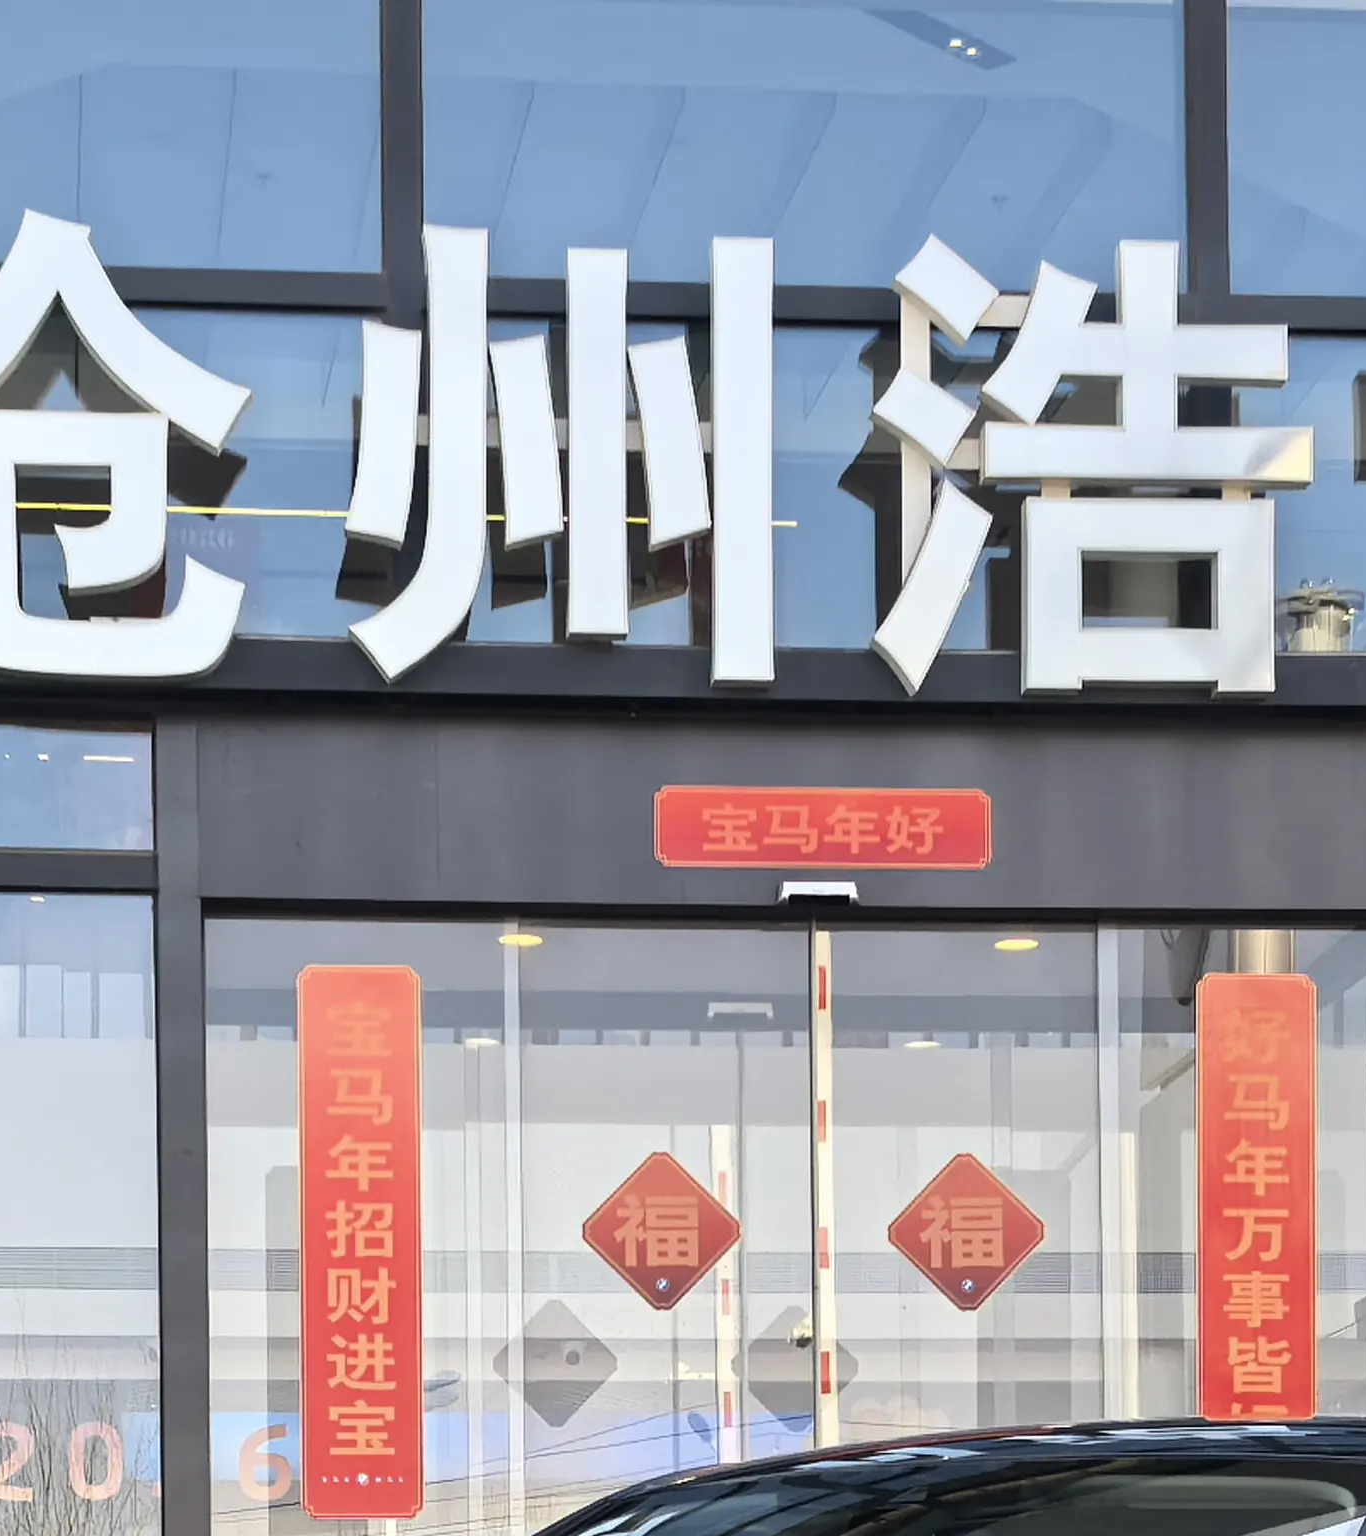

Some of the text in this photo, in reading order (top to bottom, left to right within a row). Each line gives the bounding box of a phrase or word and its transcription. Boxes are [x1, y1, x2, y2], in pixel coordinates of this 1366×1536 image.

[700, 801, 946, 857] 宝马年好
[323, 1000, 399, 1458] 宝马年招财进宝
[613, 1194, 700, 1270] 福
[919, 1195, 1006, 1269] 福
[1221, 1007, 1293, 1417] 好马年万事皆
